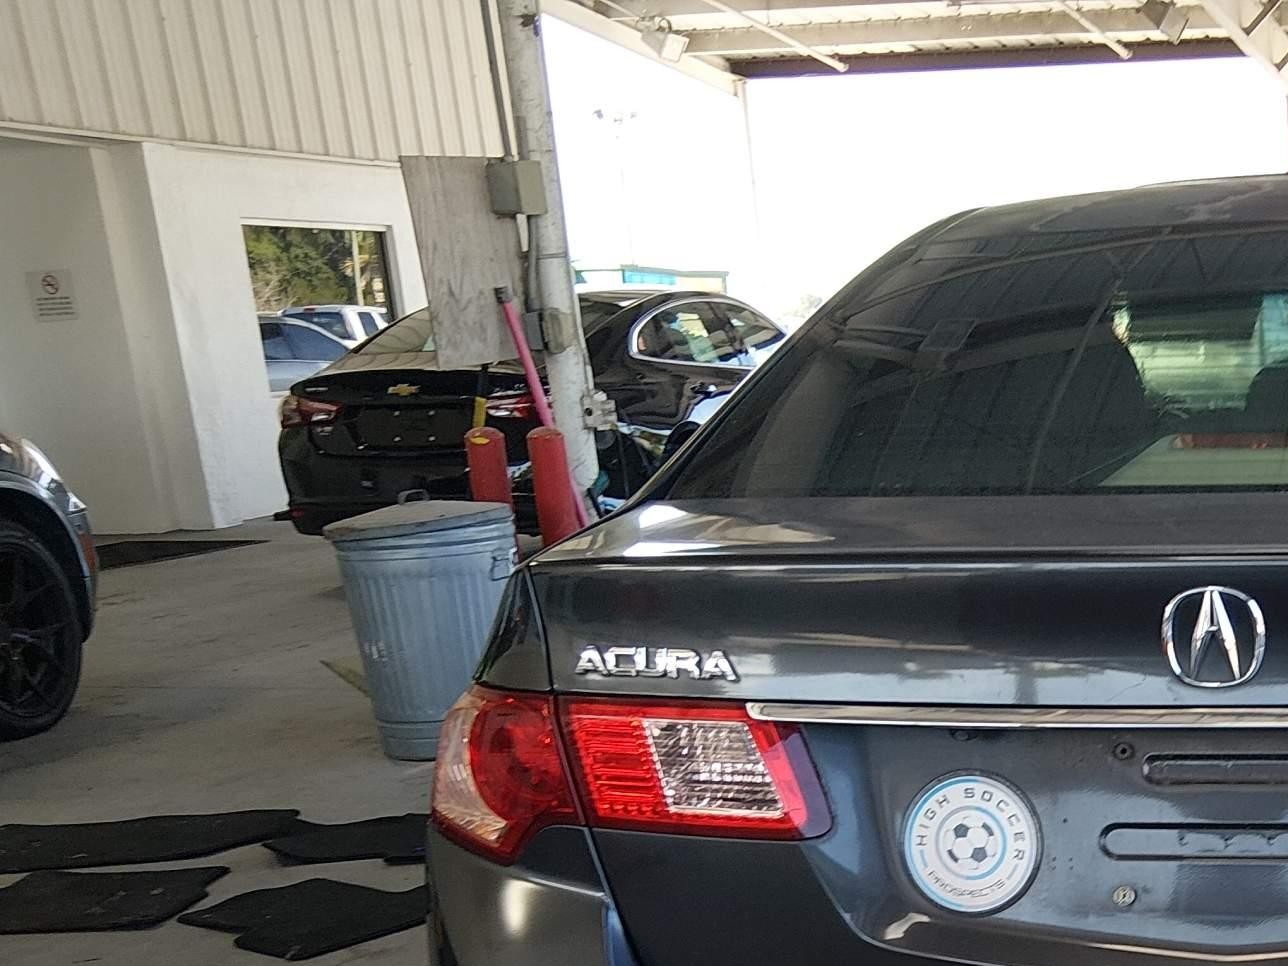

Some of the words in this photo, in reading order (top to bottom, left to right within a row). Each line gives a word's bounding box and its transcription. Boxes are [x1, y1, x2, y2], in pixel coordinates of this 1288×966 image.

[574, 644, 740, 683] ACURA
[915, 794, 951, 847] HIGH
[962, 786, 1026, 862] SOCCER
